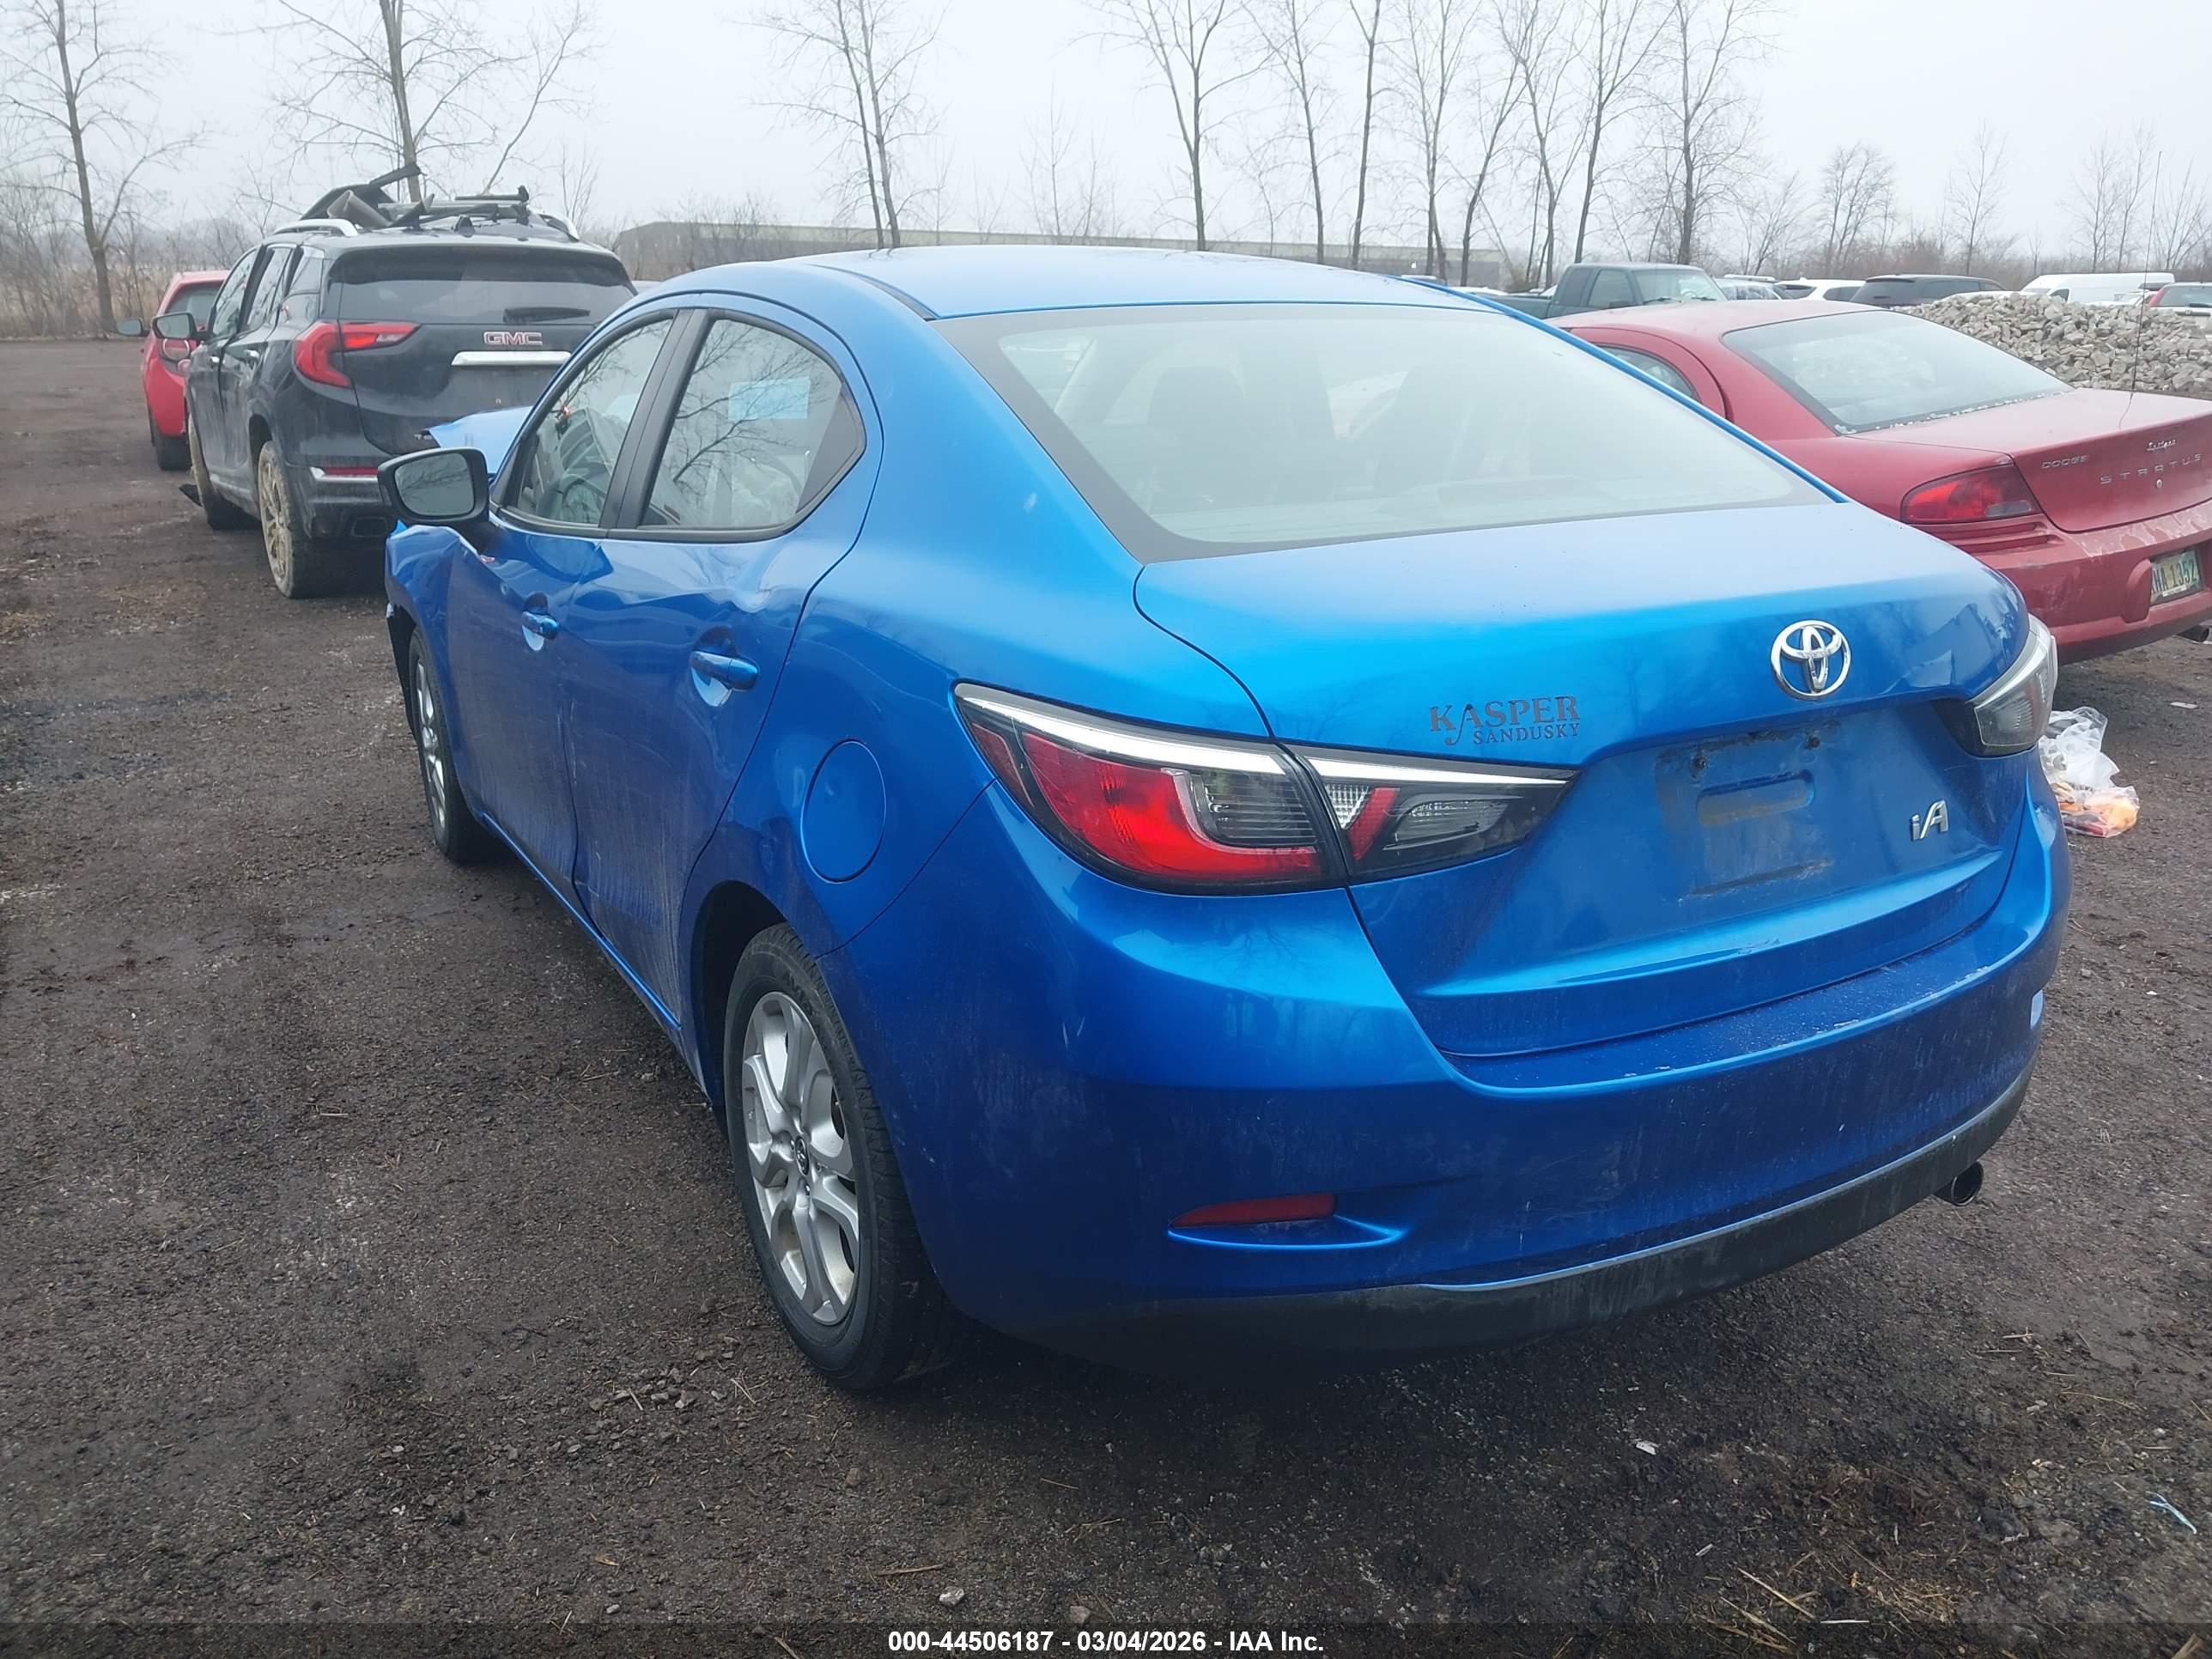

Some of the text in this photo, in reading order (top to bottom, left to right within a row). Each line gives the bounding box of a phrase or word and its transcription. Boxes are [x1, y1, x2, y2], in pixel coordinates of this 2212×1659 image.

[483, 331, 544, 346] GMC
[2042, 455, 2089, 469] DODGE
[2100, 453, 2203, 485] STRATUS
[2152, 567, 2169, 594] HA
[2170, 560, 2197, 587] 1352
[1429, 695, 1581, 746] KASPER
[1473, 722, 1580, 745] SANDUSKY
